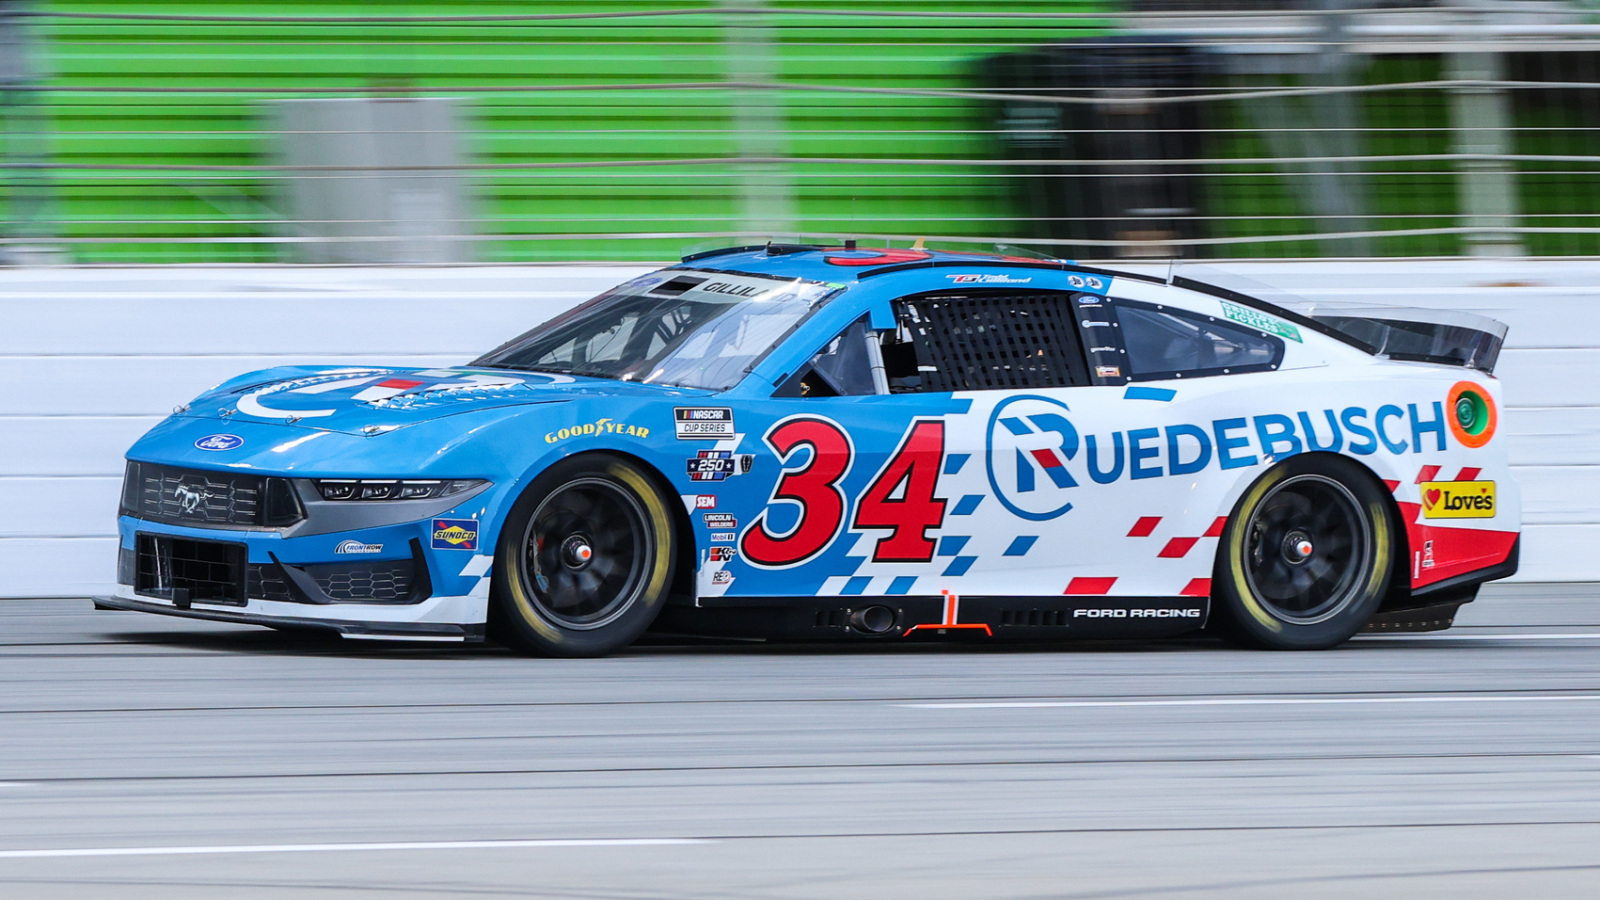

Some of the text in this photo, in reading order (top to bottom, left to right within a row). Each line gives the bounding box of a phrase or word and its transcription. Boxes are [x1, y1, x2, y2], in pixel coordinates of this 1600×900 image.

[693, 410, 724, 419] NASCAR
[544, 419, 650, 443] GOODYEAR
[684, 423, 726, 432] CUP SERIES
[199, 435, 240, 449] Ford
[997, 401, 1447, 493] RUEDEBUSCH
[698, 459, 725, 471] 250
[738, 414, 949, 569] 34
[697, 496, 715, 507] SEM
[435, 531, 475, 540] SUNOCO
[1073, 608, 1201, 618] FORD RACING
